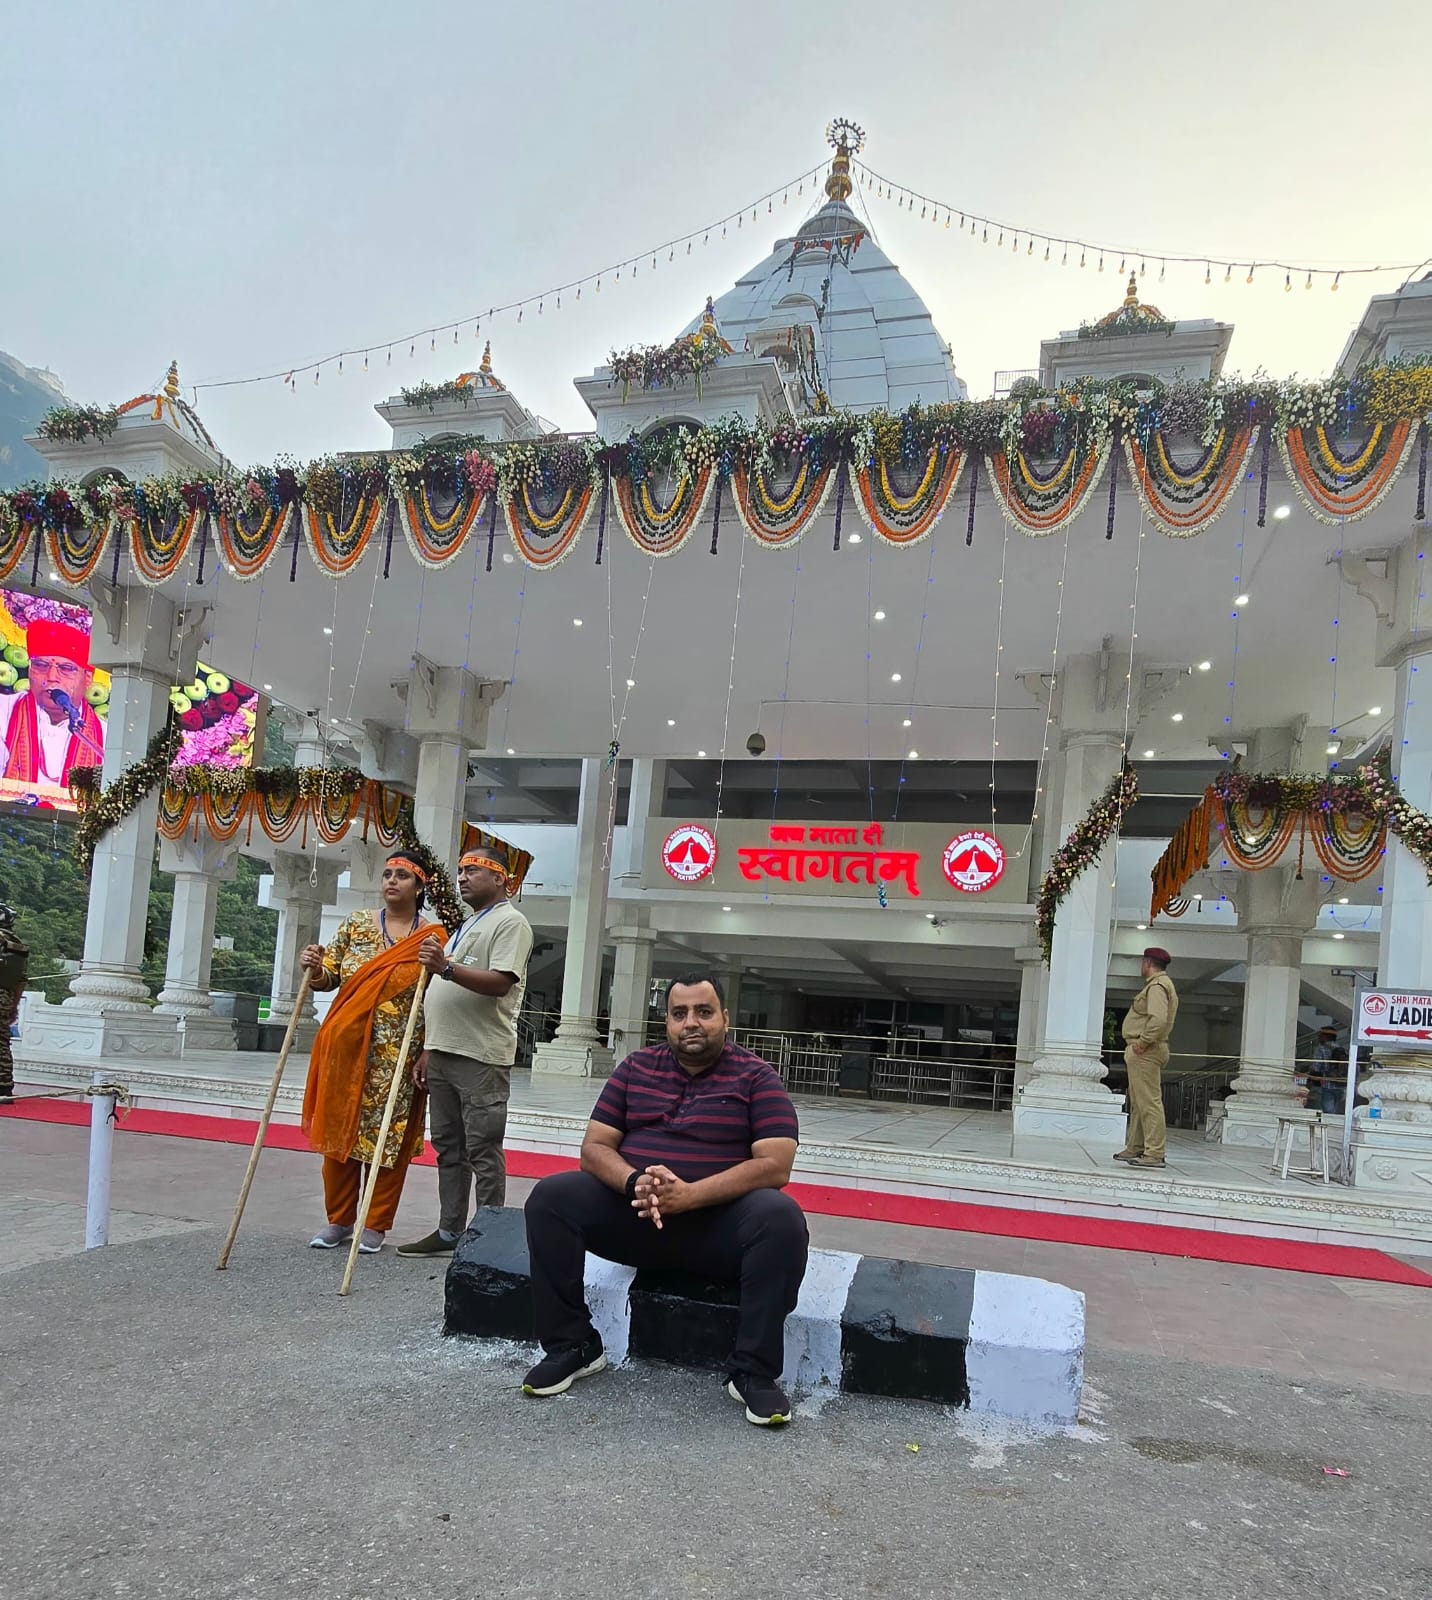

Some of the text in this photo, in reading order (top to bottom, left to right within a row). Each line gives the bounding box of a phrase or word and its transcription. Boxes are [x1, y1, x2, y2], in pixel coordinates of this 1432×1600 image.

[770, 821, 883, 846] जय माता दी
[737, 847, 920, 897] स्वागतम्
[1391, 995, 1431, 1005] SHRI MATA
